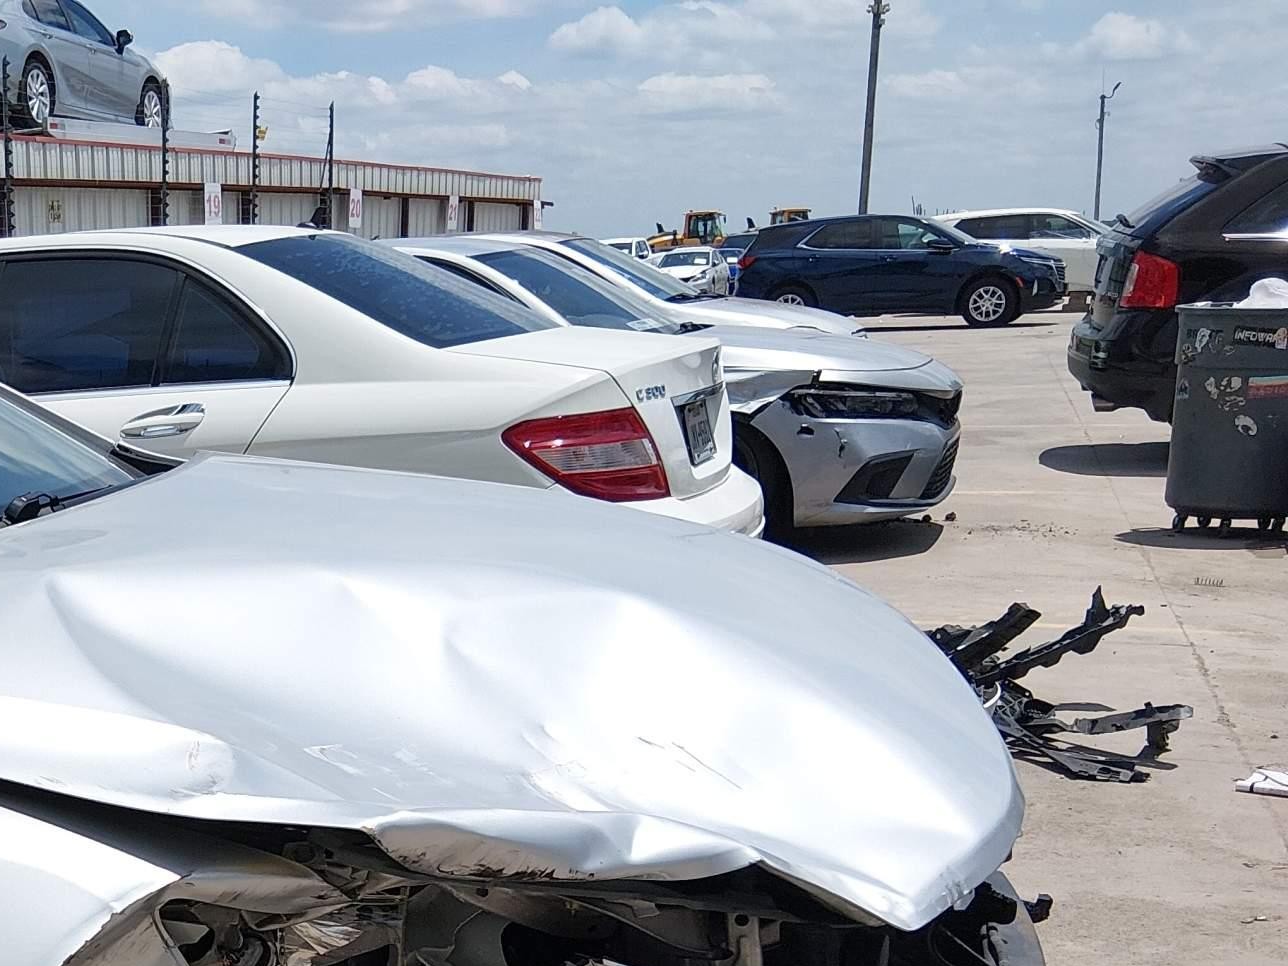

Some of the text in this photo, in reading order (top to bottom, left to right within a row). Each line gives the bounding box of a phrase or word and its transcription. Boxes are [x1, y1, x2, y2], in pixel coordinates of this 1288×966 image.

[206, 194, 221, 218] 19
[349, 199, 361, 218] 20
[1234, 329, 1287, 343] INFOWA
